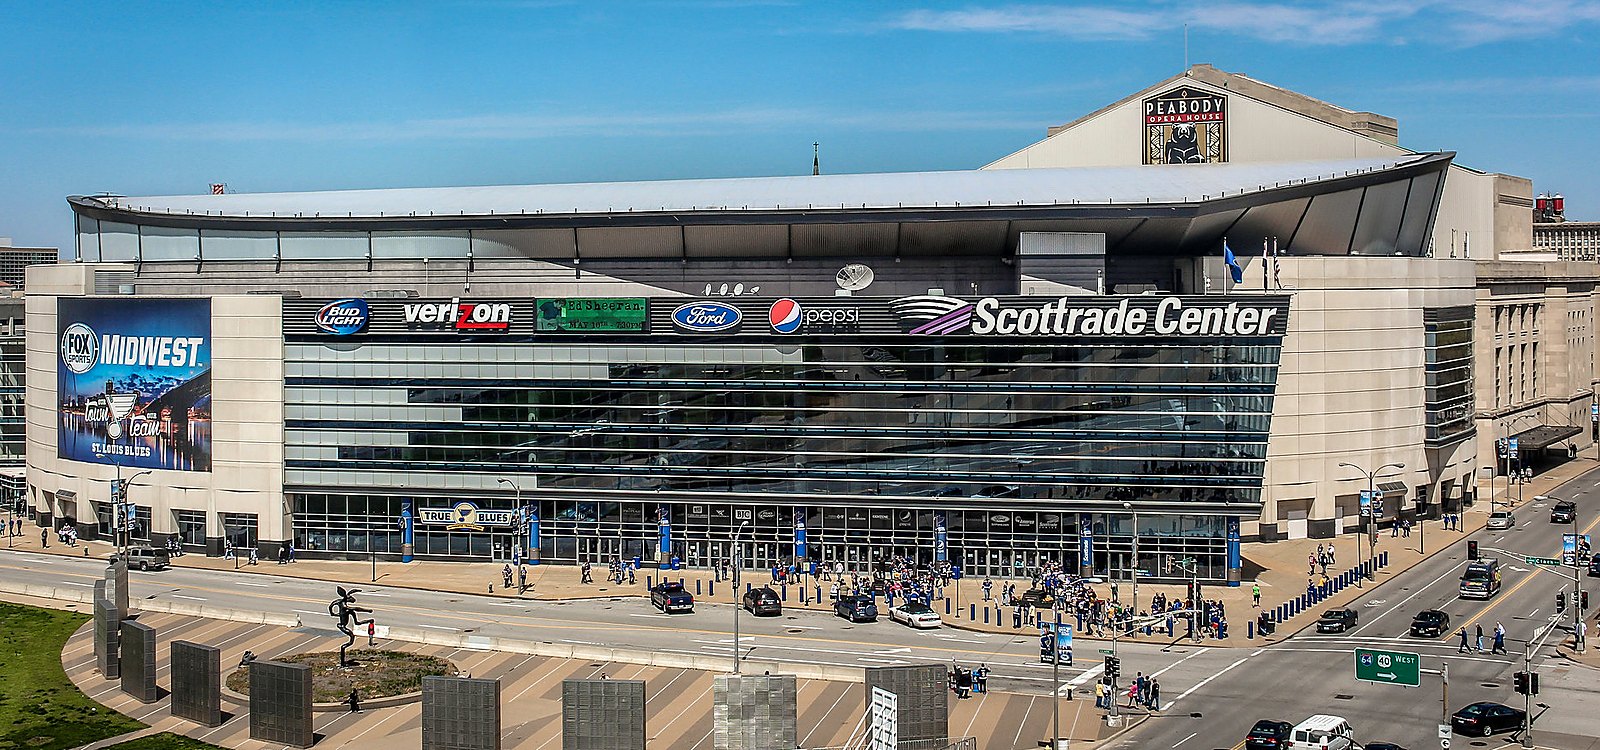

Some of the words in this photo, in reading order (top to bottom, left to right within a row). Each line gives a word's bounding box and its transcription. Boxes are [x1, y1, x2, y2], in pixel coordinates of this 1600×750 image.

[1146, 98, 1223, 116] PEABODY
[1149, 115, 1182, 123] OPERA
[1186, 113, 1220, 121] HOUSE
[328, 306, 360, 316] BUD
[403, 297, 510, 329] verizon
[569, 300, 583, 311] Ed
[320, 316, 365, 325] LIGHT
[686, 306, 727, 325] Ford
[806, 306, 859, 326] pepsi
[971, 296, 1154, 335] Scottrade
[1154, 297, 1278, 335] Center
[68, 333, 91, 354] FOX
[100, 334, 204, 367] MIDWEST
[68, 354, 91, 364] SPORTS
[129, 413, 161, 436] team
[102, 444, 124, 455] LOUIS
[124, 445, 151, 457] BLUES
[425, 512, 451, 521] TRUE
[478, 513, 508, 523] BLUES
[1379, 656, 1390, 666] 40
[1395, 655, 1415, 664] WEST
